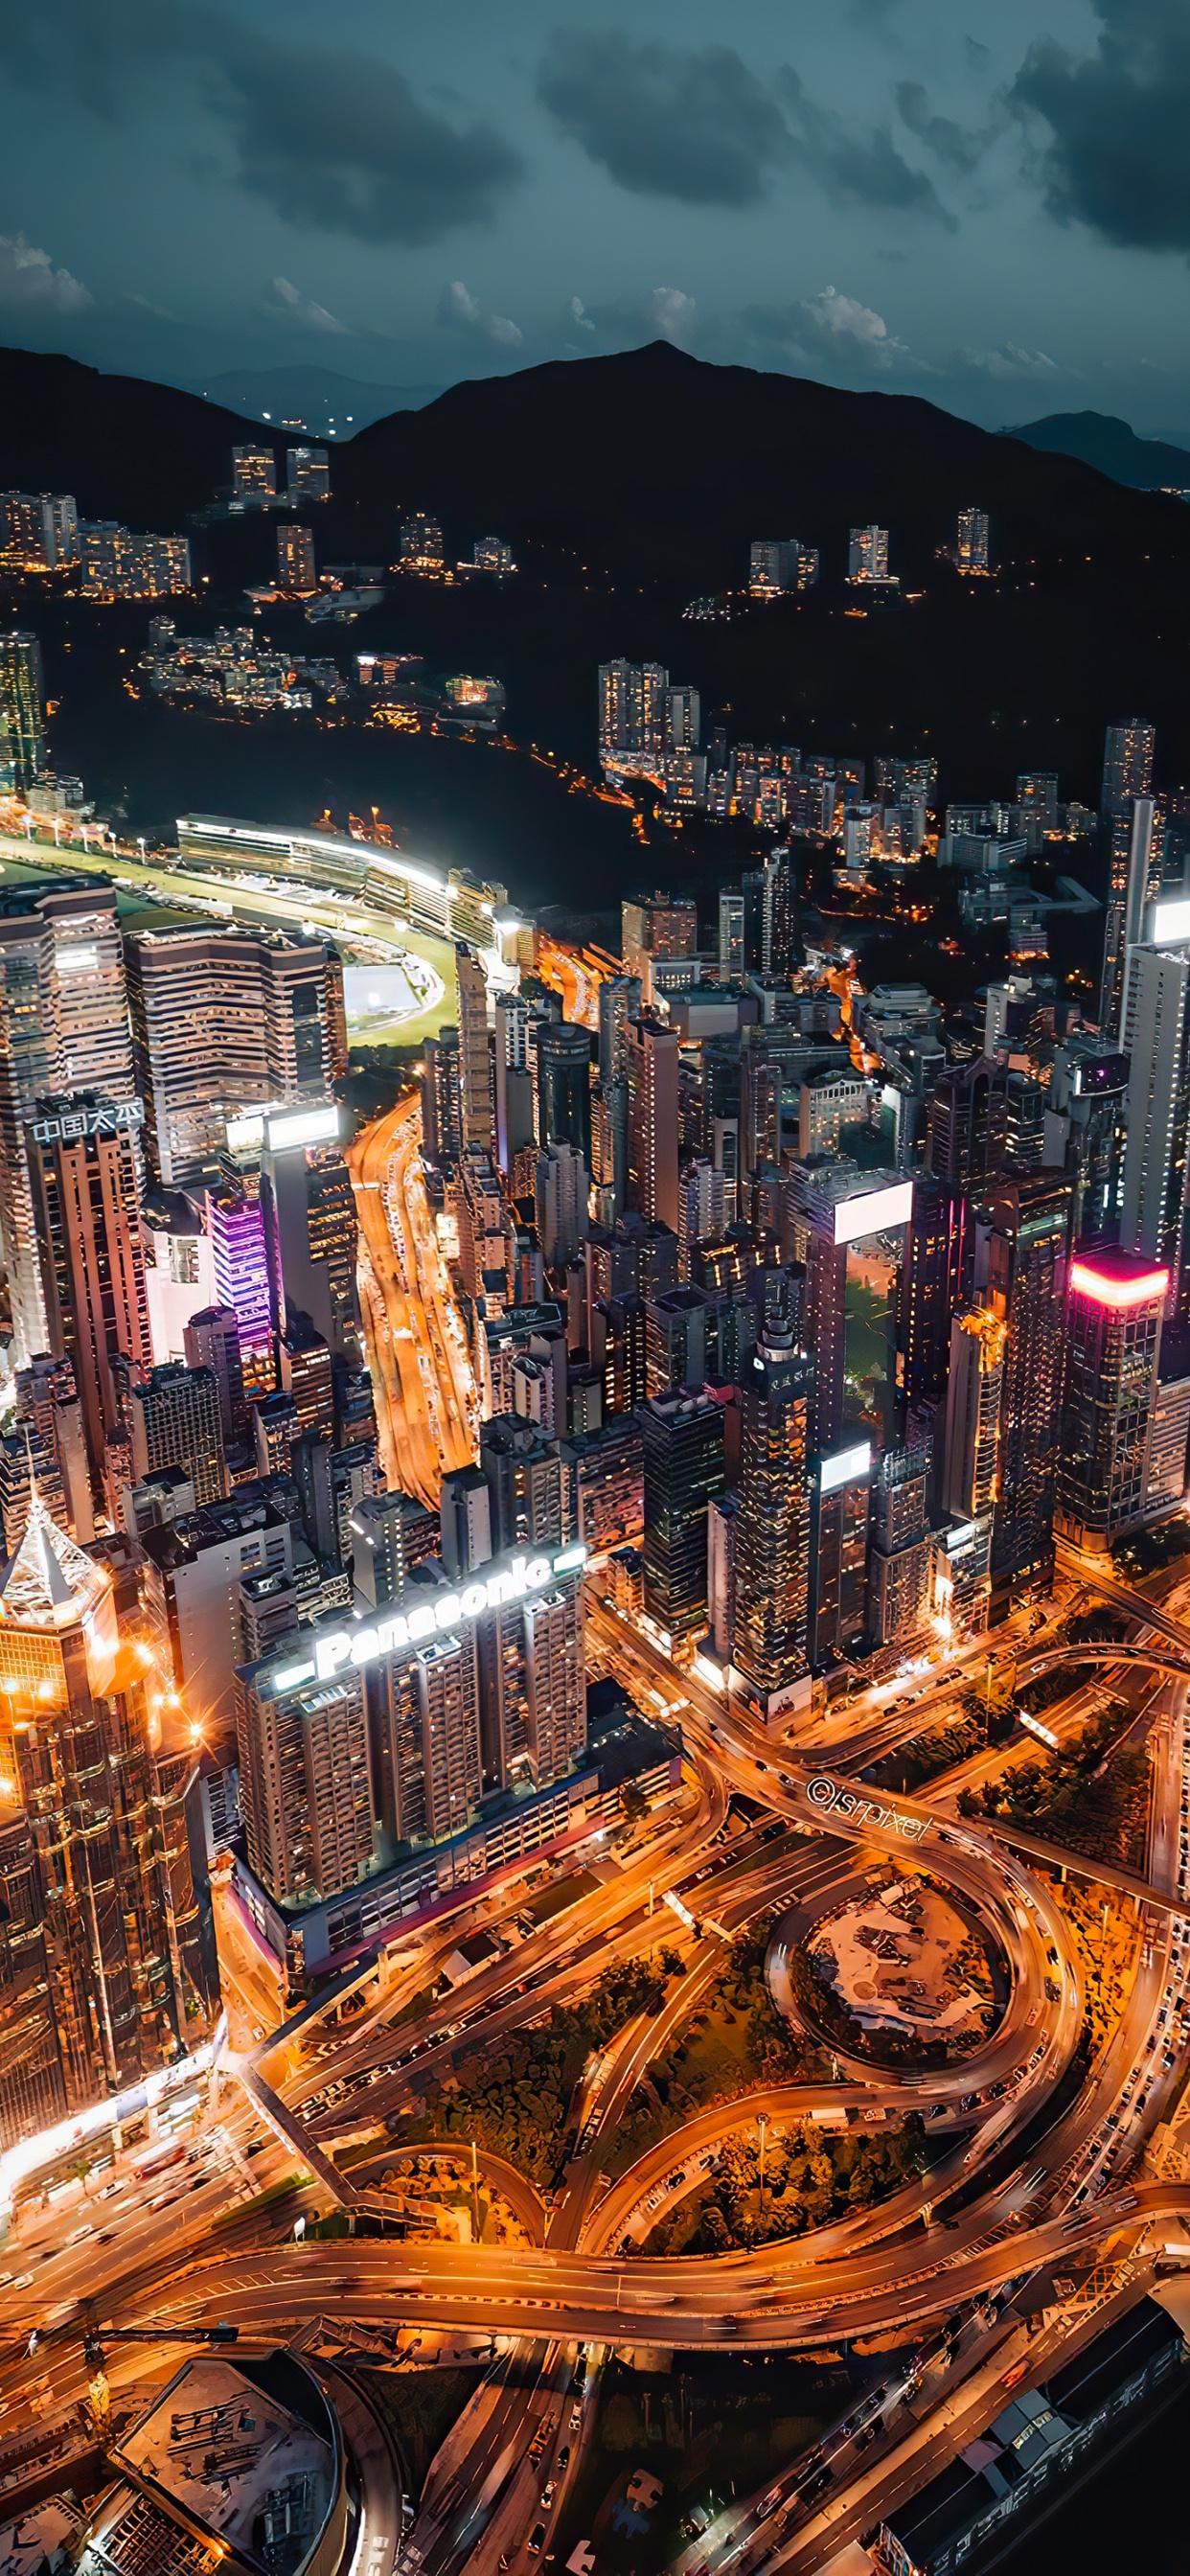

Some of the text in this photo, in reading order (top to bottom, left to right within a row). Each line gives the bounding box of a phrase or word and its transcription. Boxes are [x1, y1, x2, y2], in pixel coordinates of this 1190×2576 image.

[31, 1101, 142, 1143] 中国太平
[314, 1556, 552, 1680] Panasonic
